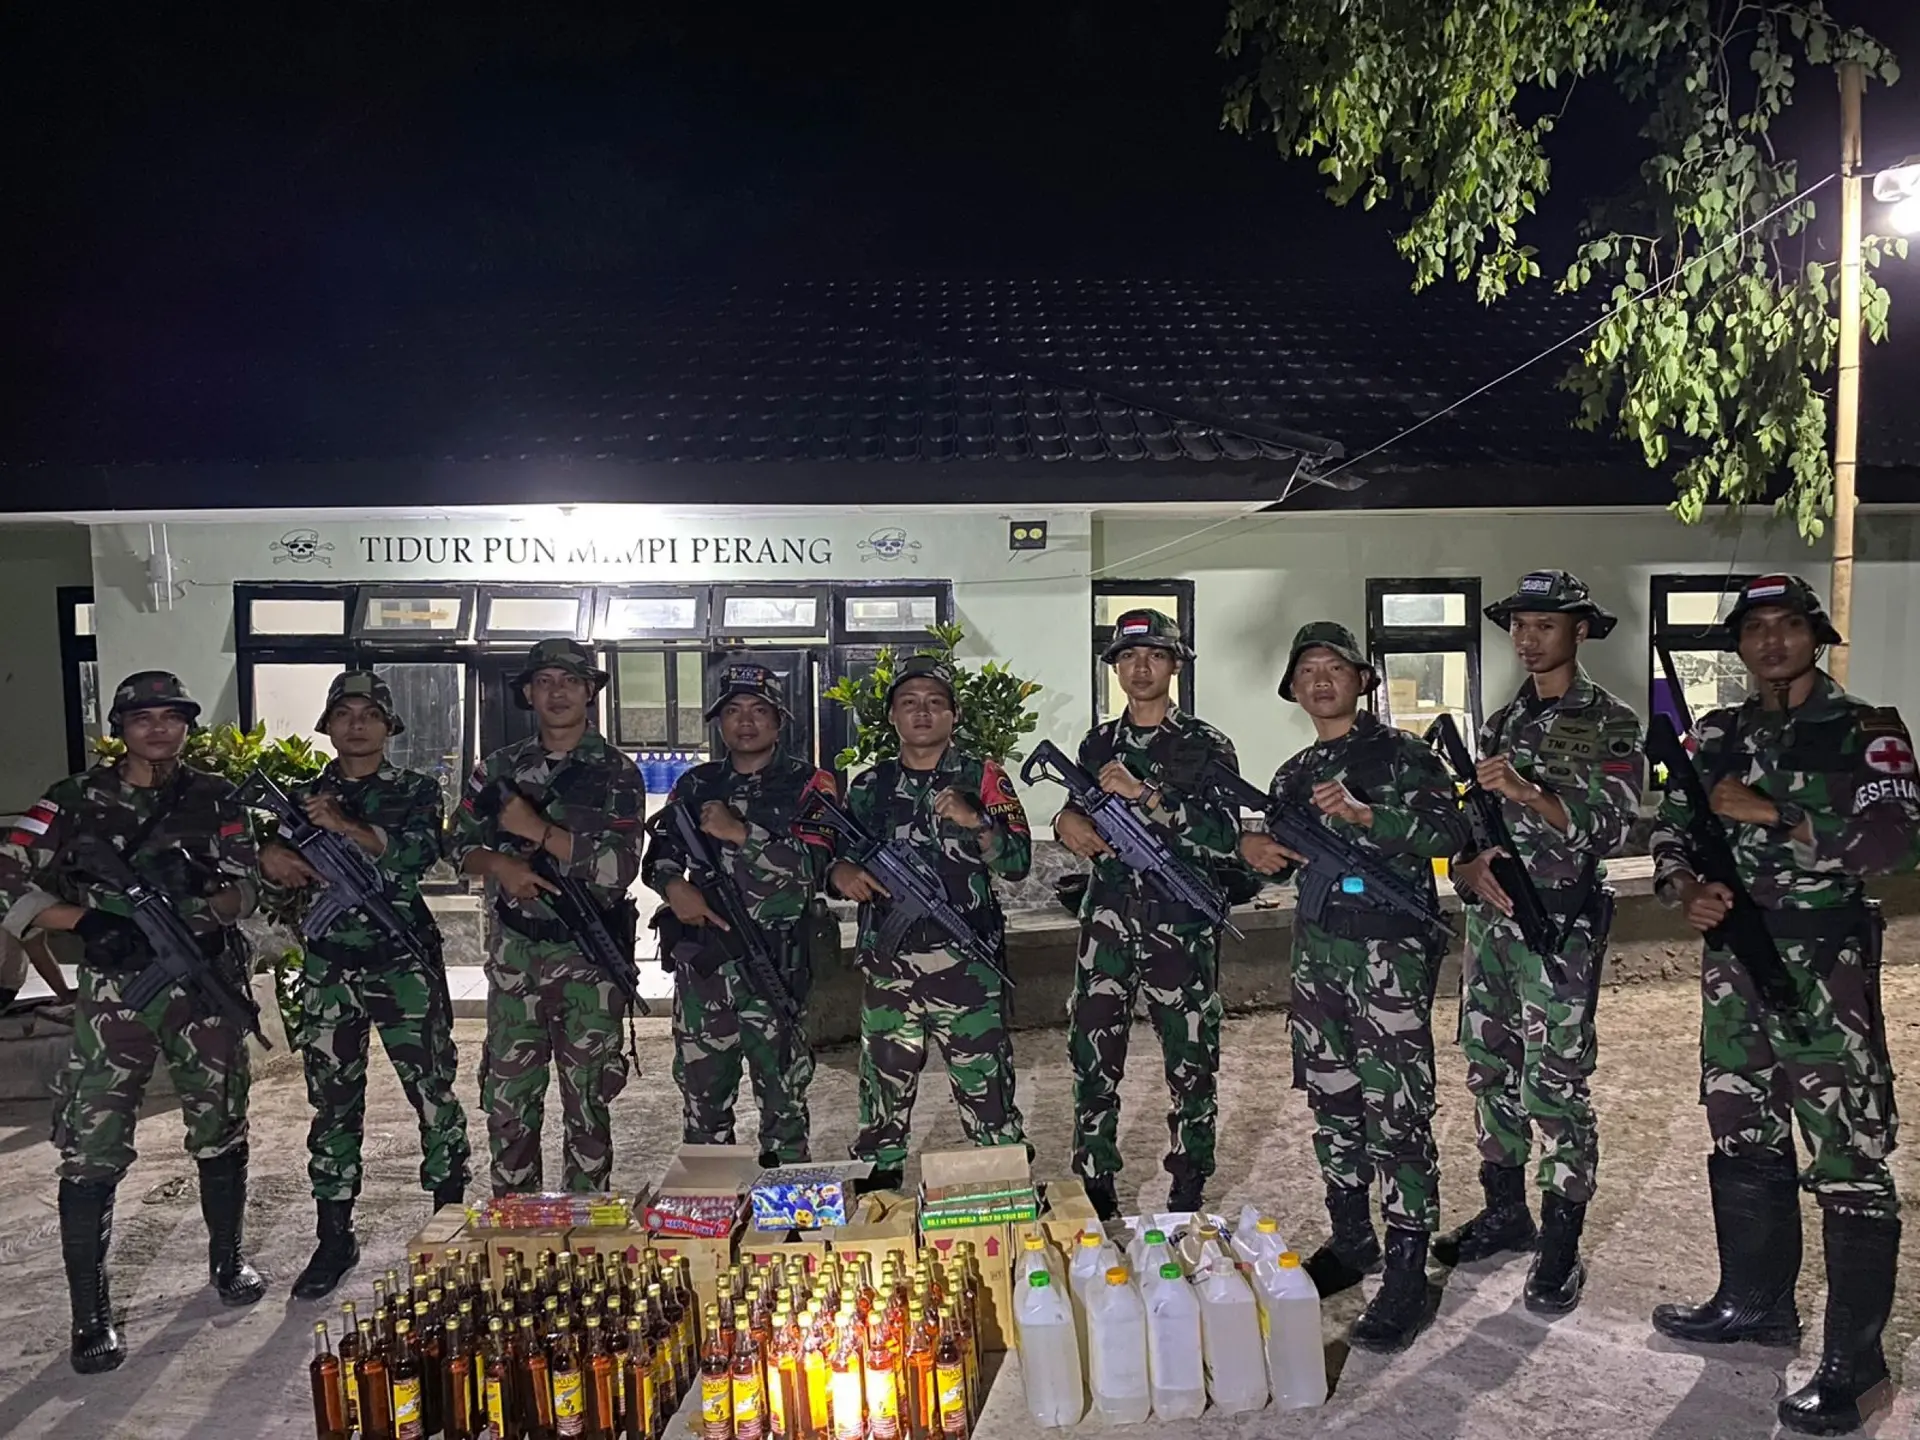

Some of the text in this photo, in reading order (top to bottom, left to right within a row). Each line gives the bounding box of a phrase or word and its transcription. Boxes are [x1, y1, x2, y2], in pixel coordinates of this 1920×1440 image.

[359, 536, 833, 565] TIDUR PUN MMPI PERANG
[1547, 739, 1590, 754] TNI AD
